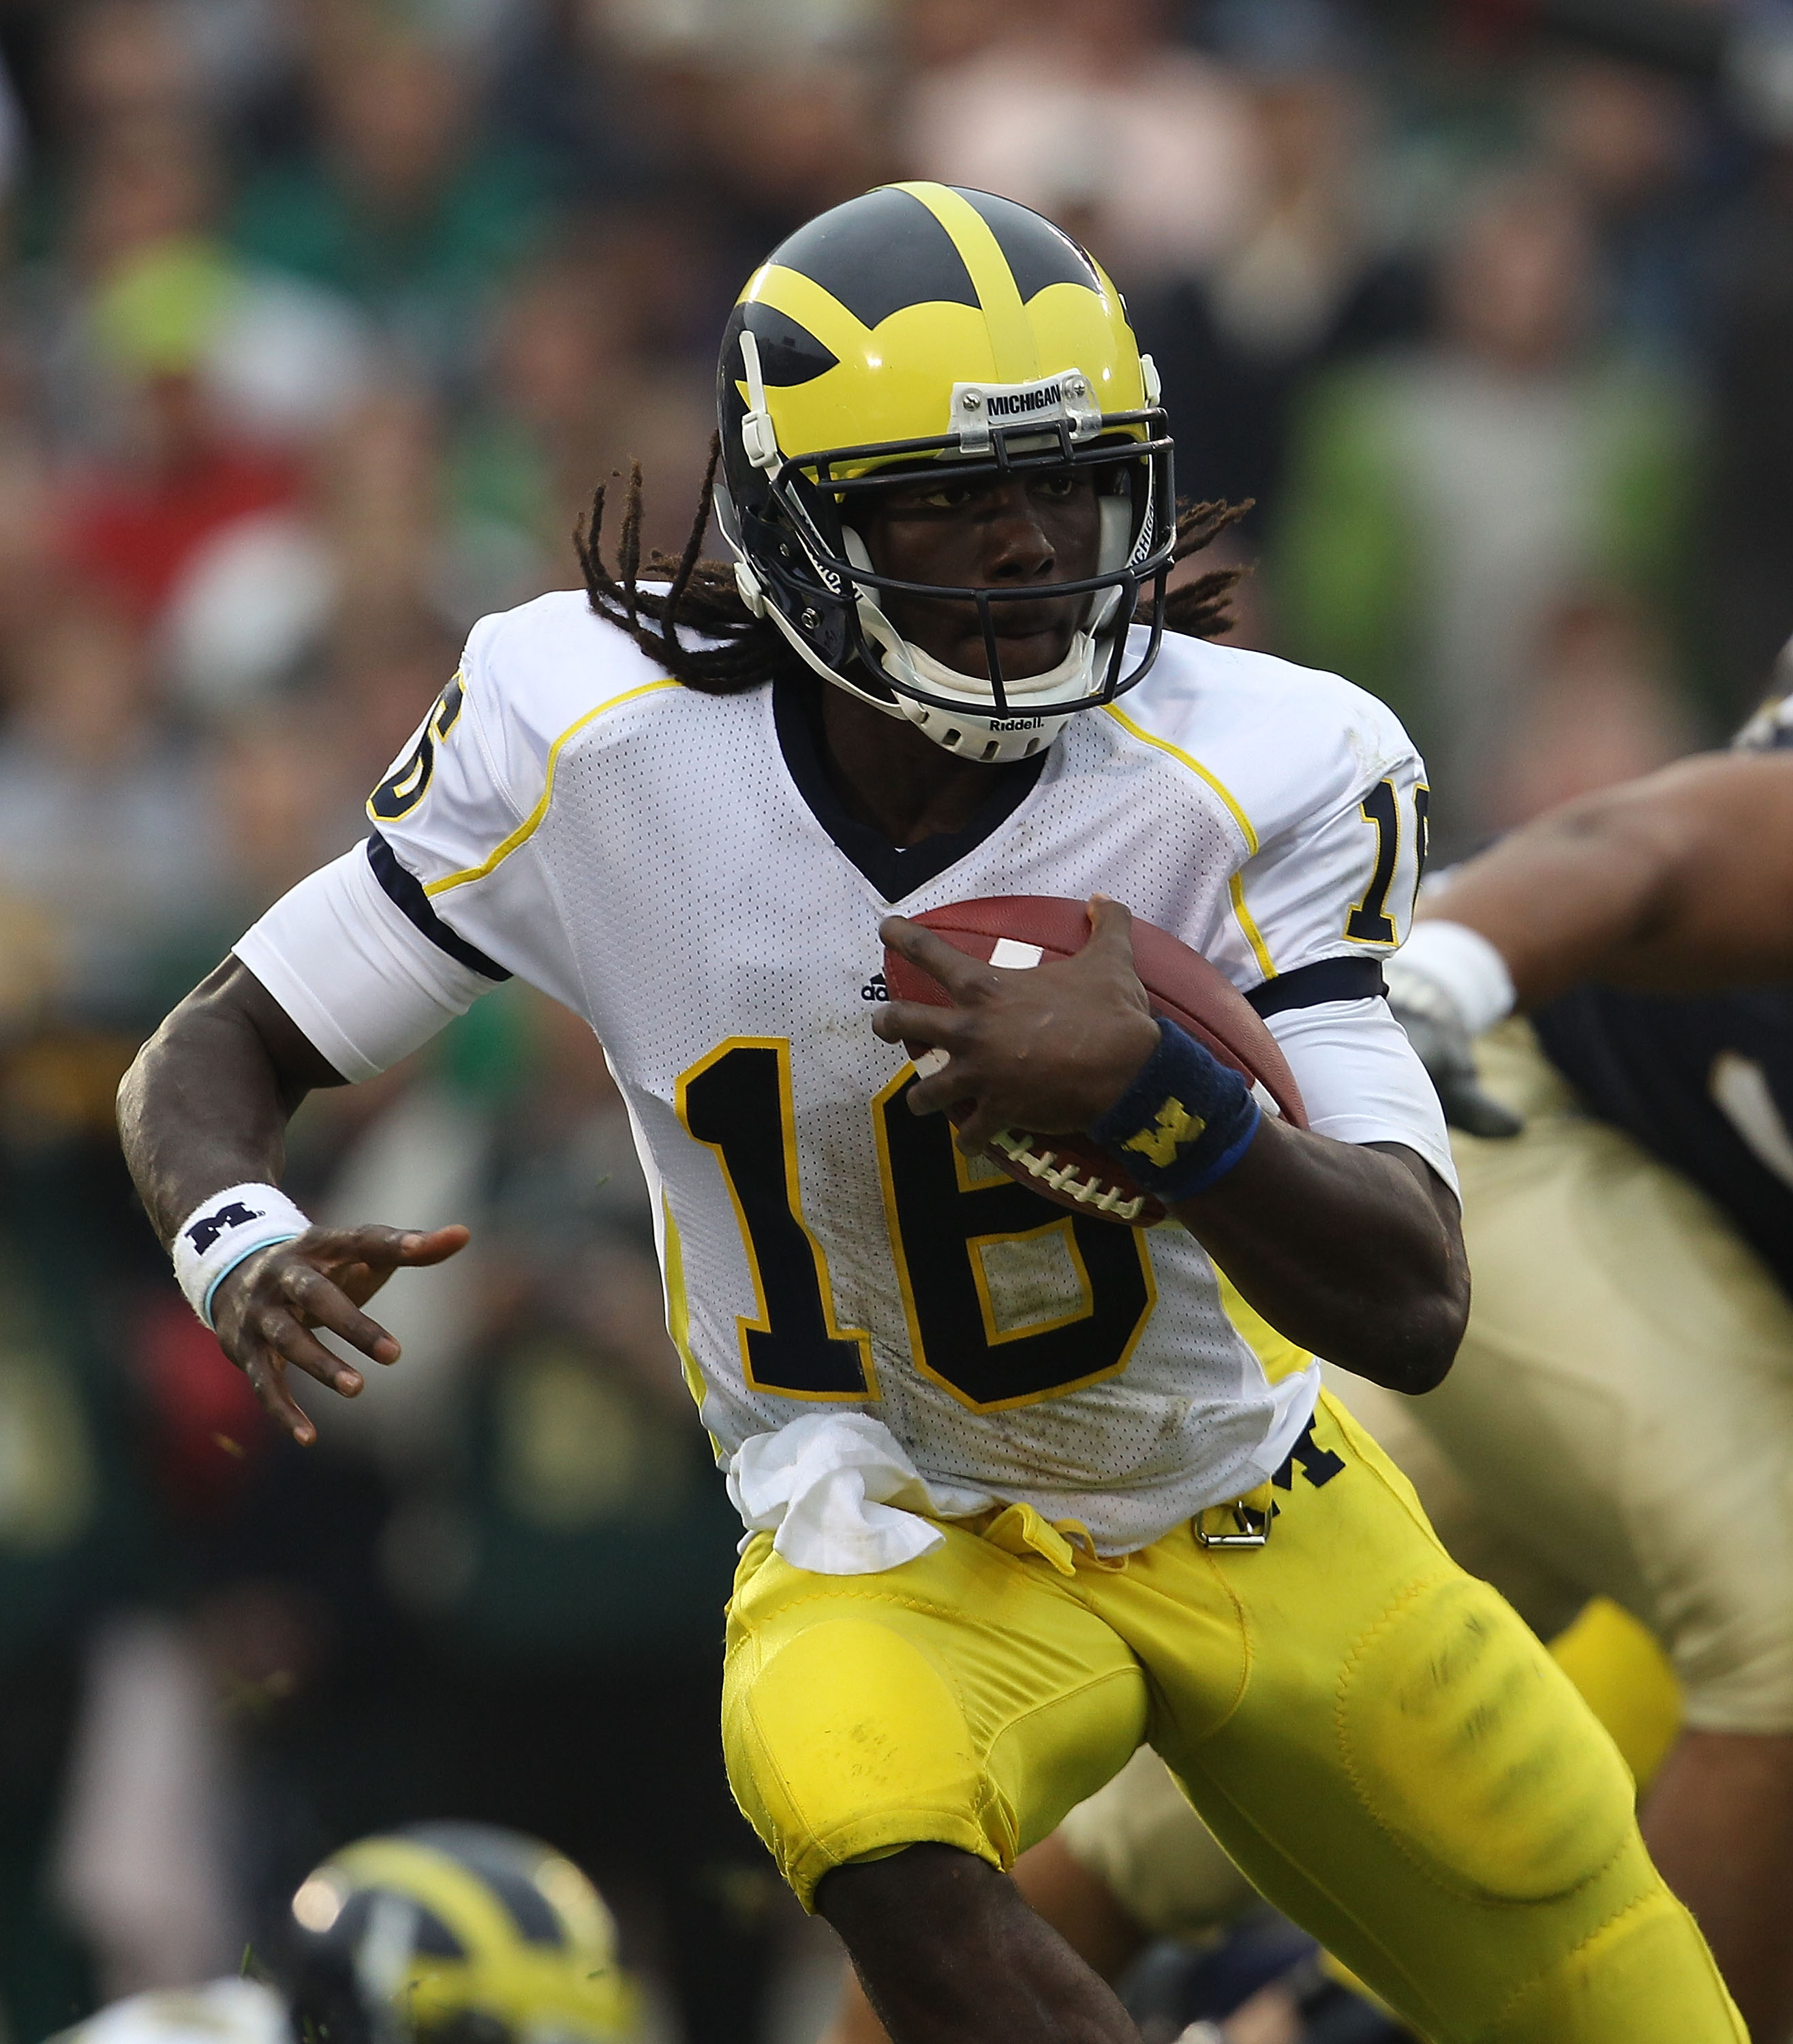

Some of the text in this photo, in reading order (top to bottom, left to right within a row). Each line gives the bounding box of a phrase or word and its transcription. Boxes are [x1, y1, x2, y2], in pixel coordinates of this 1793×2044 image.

[987, 384, 1061, 416] MICHIGAN
[184, 1201, 258, 1256] M
[673, 1035, 1157, 1415] 16
